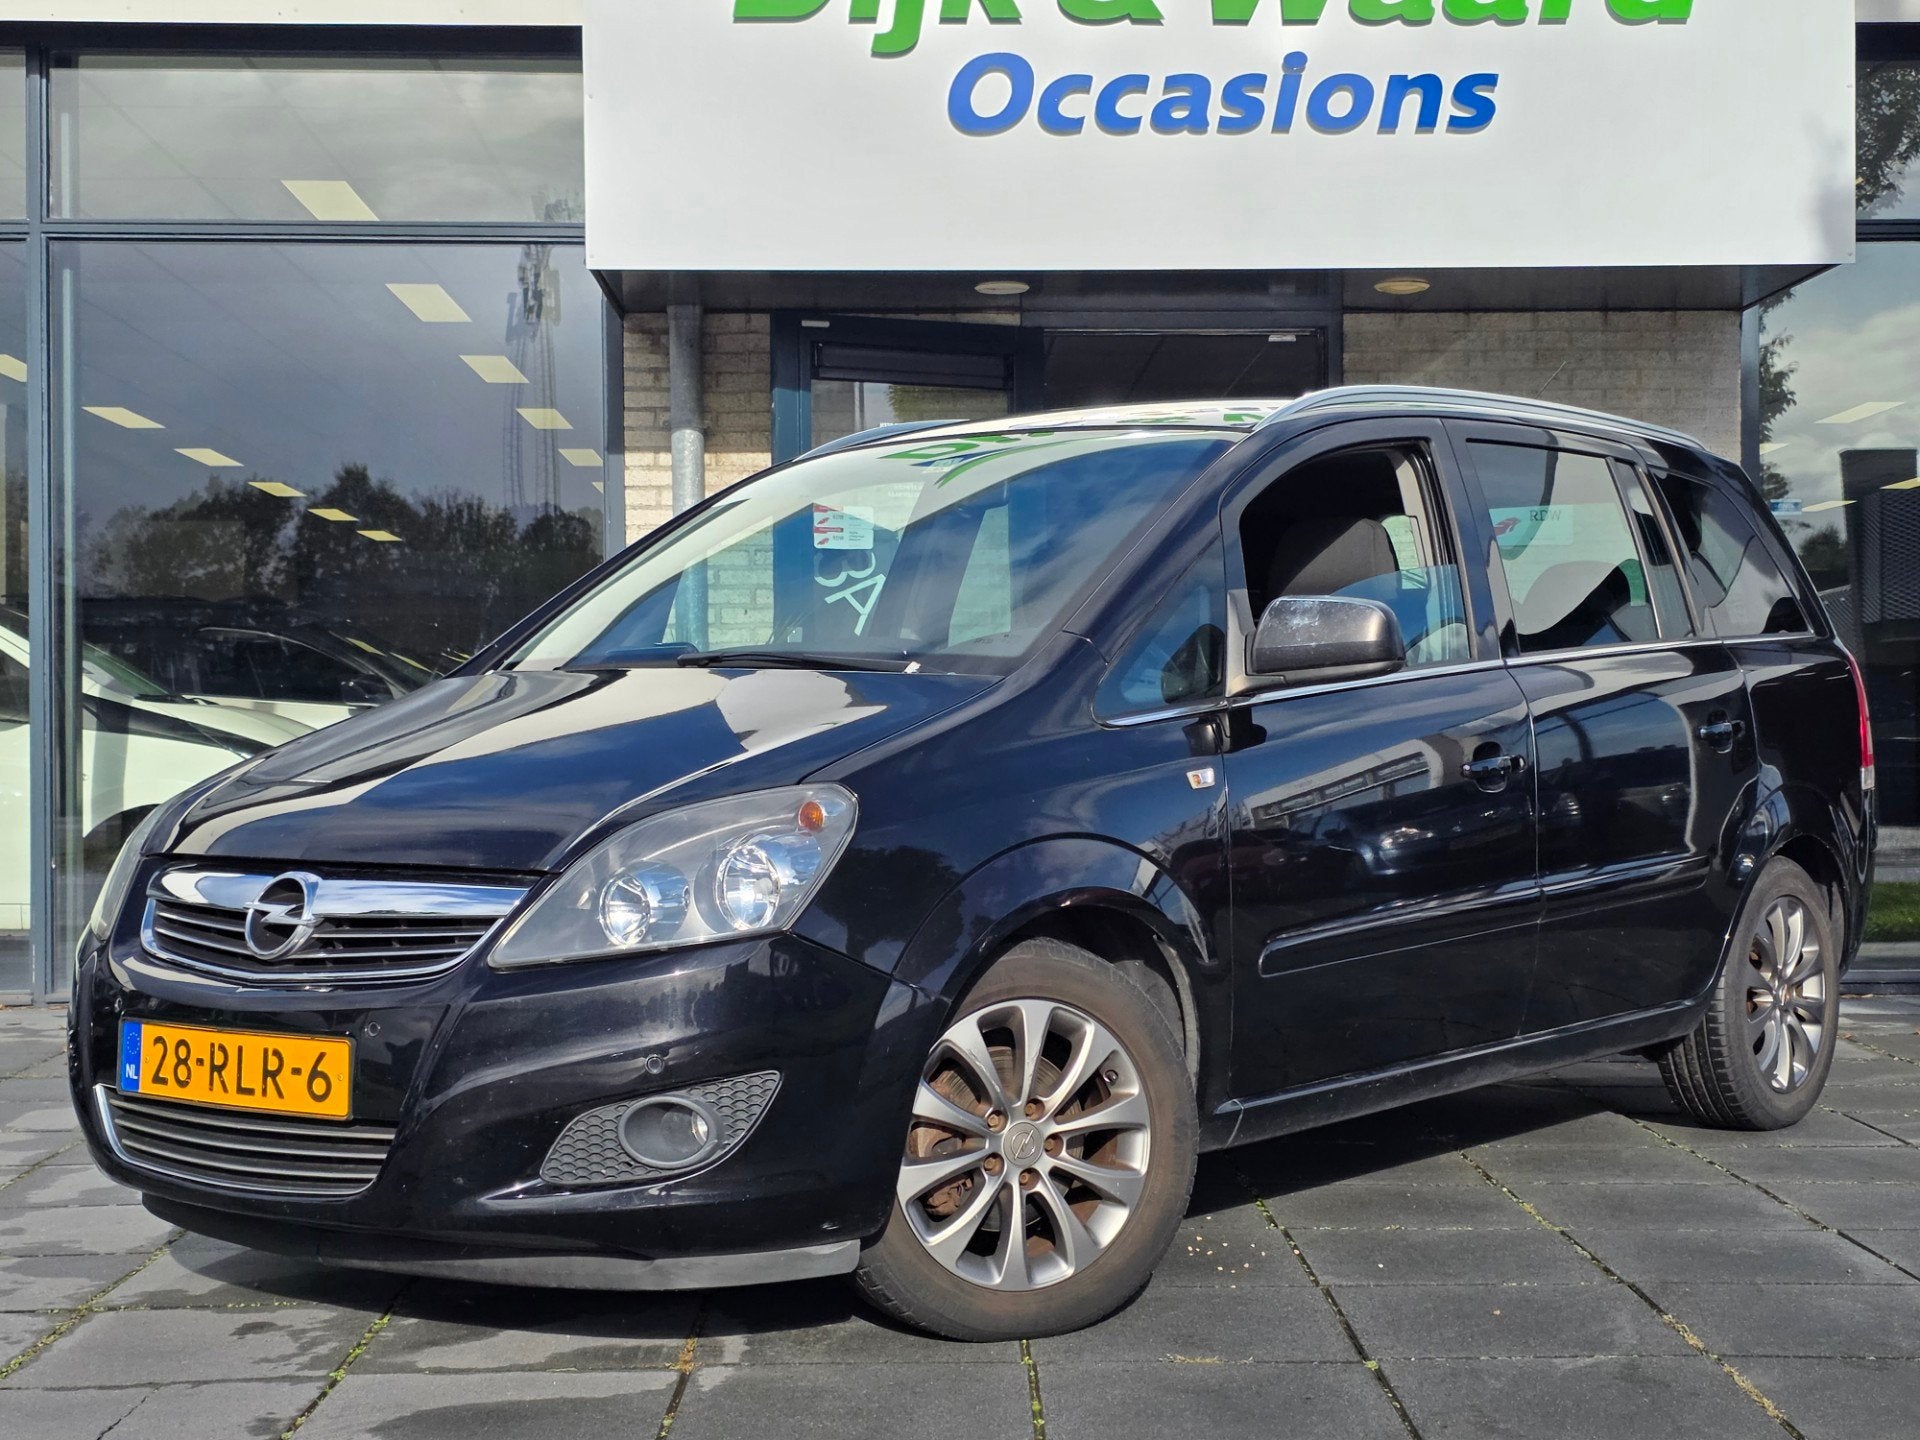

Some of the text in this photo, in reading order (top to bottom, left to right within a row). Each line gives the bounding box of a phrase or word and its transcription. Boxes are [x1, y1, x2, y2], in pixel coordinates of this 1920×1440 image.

[948, 51, 1499, 132] Occasions
[125, 1062, 139, 1080] NL
[151, 1035, 332, 1103] 28-RLR-6
